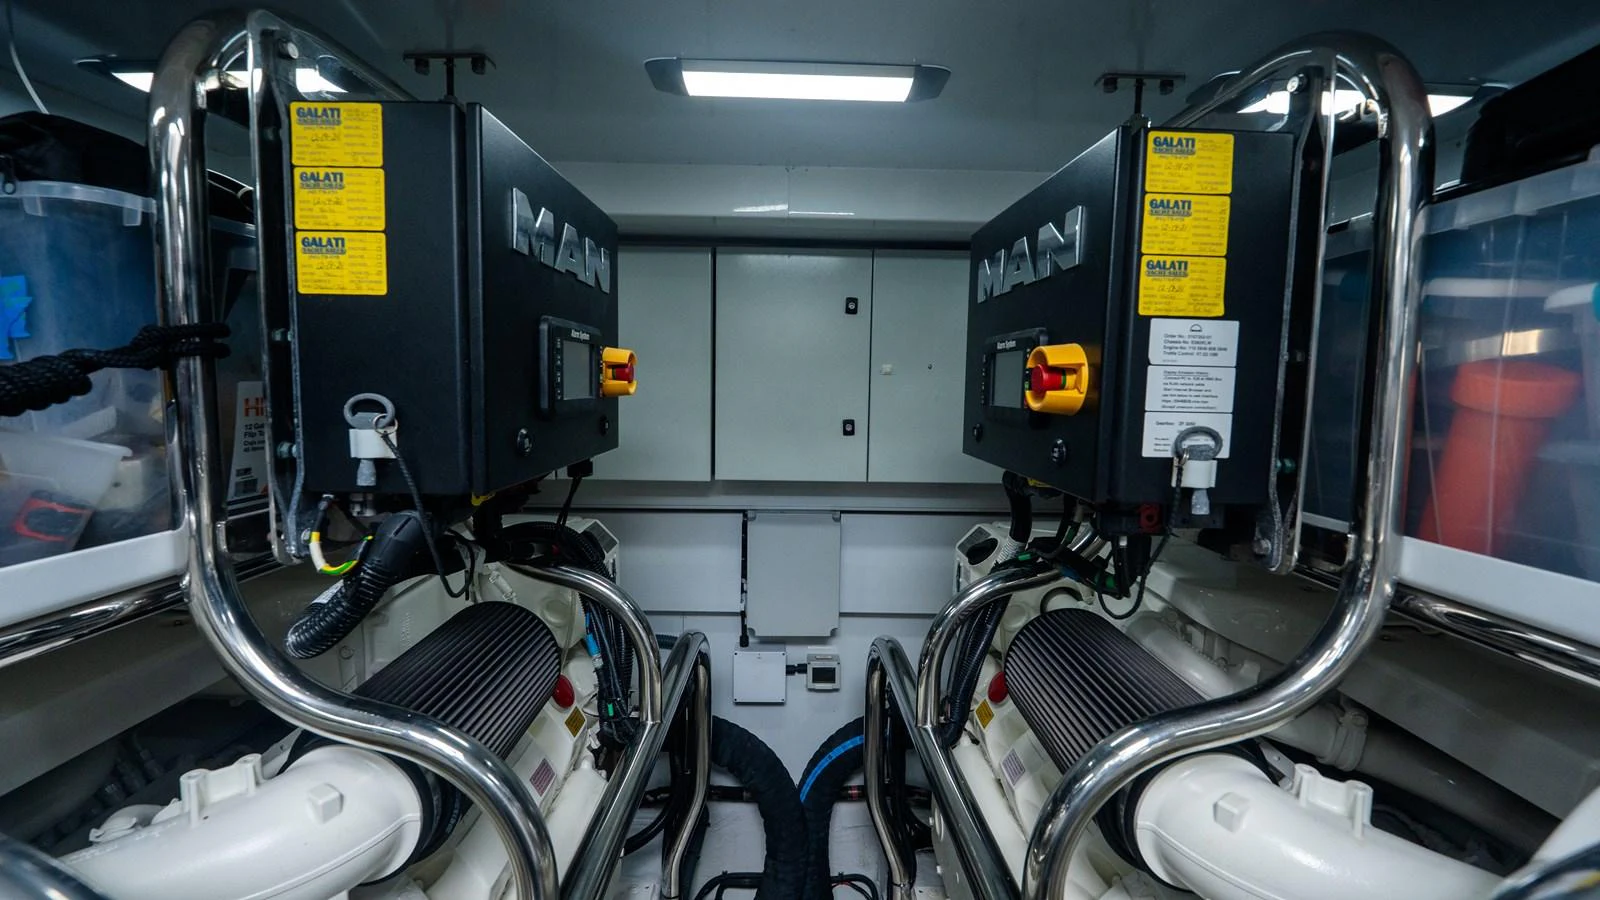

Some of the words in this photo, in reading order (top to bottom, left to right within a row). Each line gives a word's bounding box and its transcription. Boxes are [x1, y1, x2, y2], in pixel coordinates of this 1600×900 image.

[296, 107, 341, 118] GALATI
[1153, 136, 1196, 148] GALATI
[300, 172, 344, 182] GALATI
[1149, 199, 1192, 209] GALATI
[301, 237, 345, 247] GALATI
[512, 187, 610, 294] MAN
[978, 206, 1083, 304] MAN
[1146, 260, 1188, 270] GALATI
